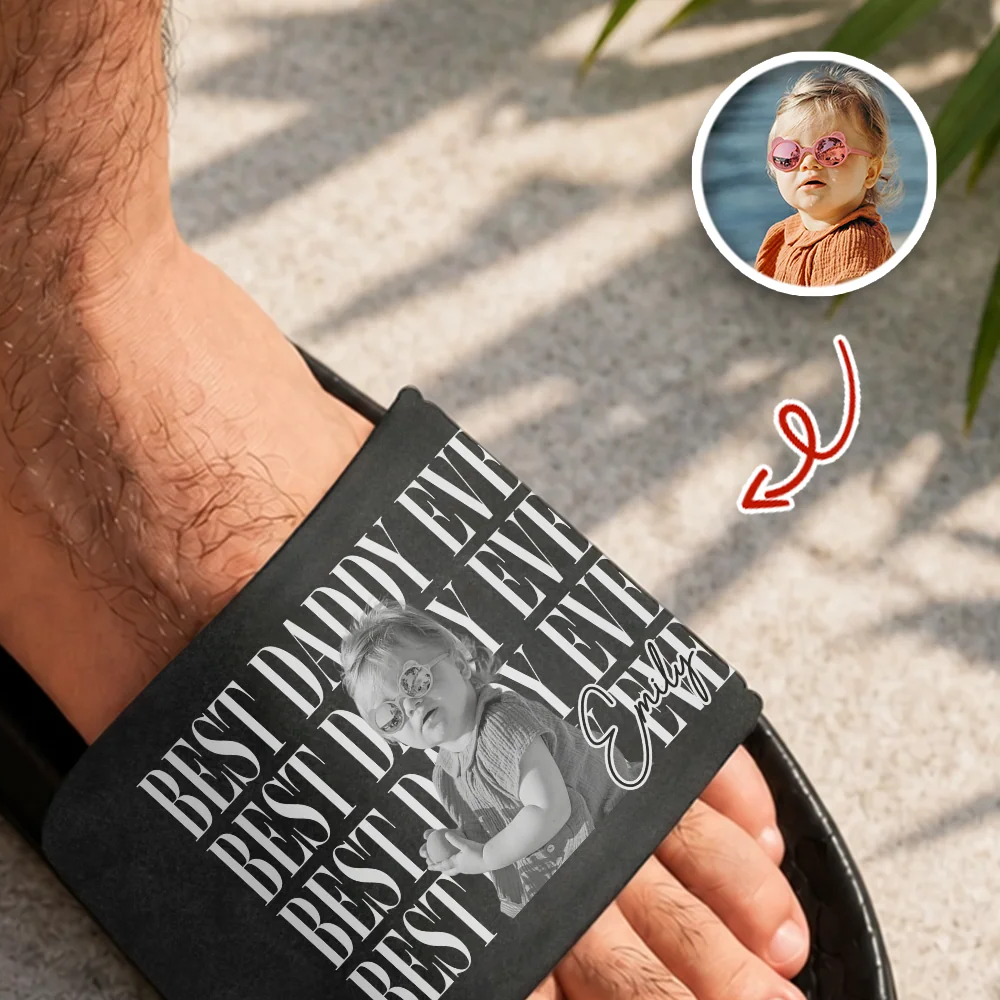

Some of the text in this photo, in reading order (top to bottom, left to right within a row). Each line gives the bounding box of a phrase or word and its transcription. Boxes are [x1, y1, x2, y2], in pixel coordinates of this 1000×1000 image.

[137, 681, 286, 841] BEST
[247, 517, 433, 719] DADDY
[578, 639, 711, 790] Emily
[207, 744, 356, 905] BEST
[277, 808, 427, 970] BEST
